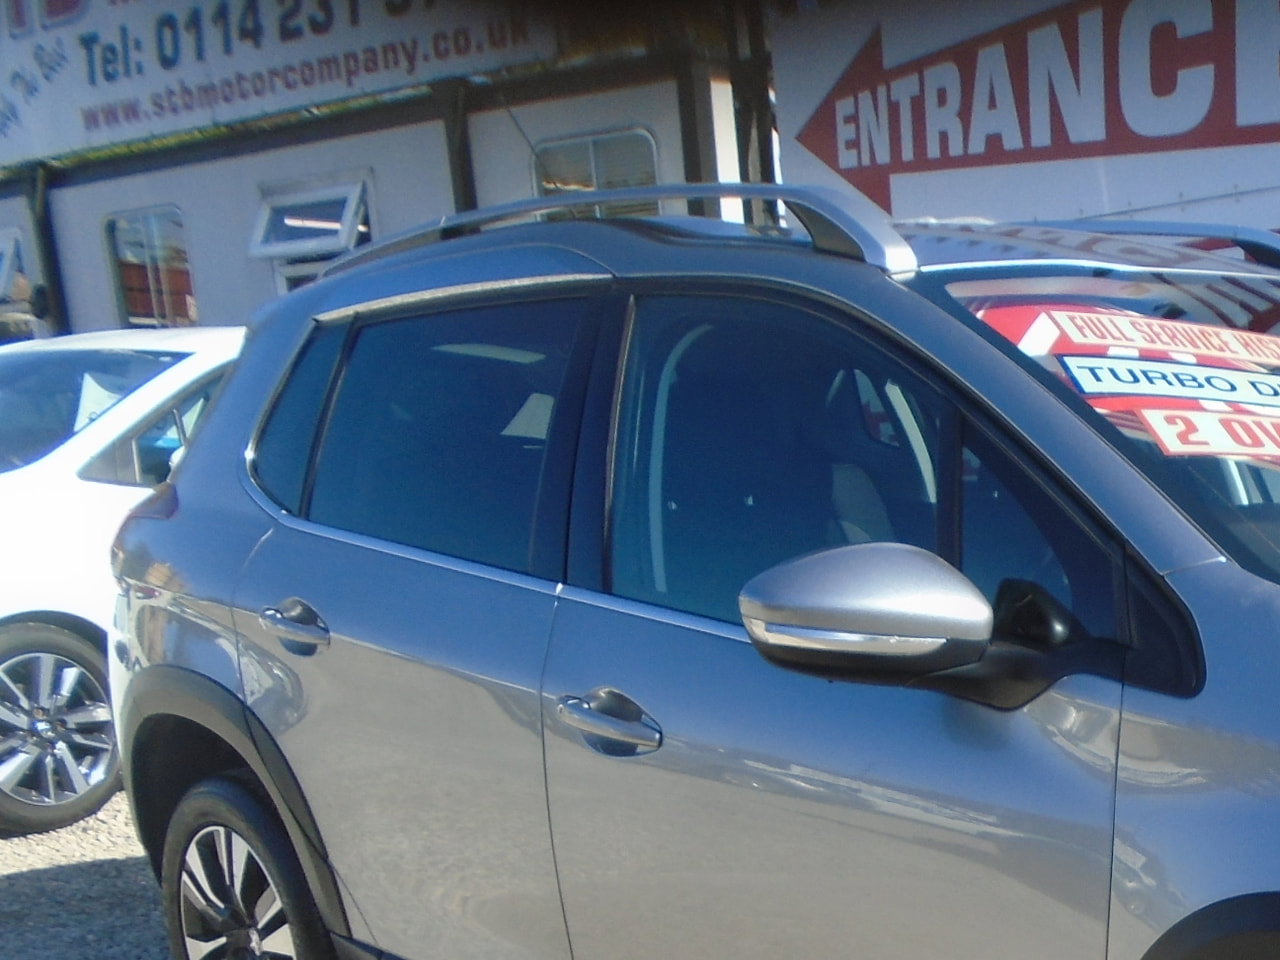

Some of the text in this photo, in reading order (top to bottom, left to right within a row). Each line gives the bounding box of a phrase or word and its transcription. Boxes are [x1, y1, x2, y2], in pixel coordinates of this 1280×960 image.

[78, 23, 144, 87] Tel:
[156, 0, 264, 71] 0114
[1065, 314, 1136, 343] FULL
[1129, 319, 1236, 355] SERVICE
[1077, 365, 1238, 393] TURBO
[1164, 414, 1210, 447] 2
